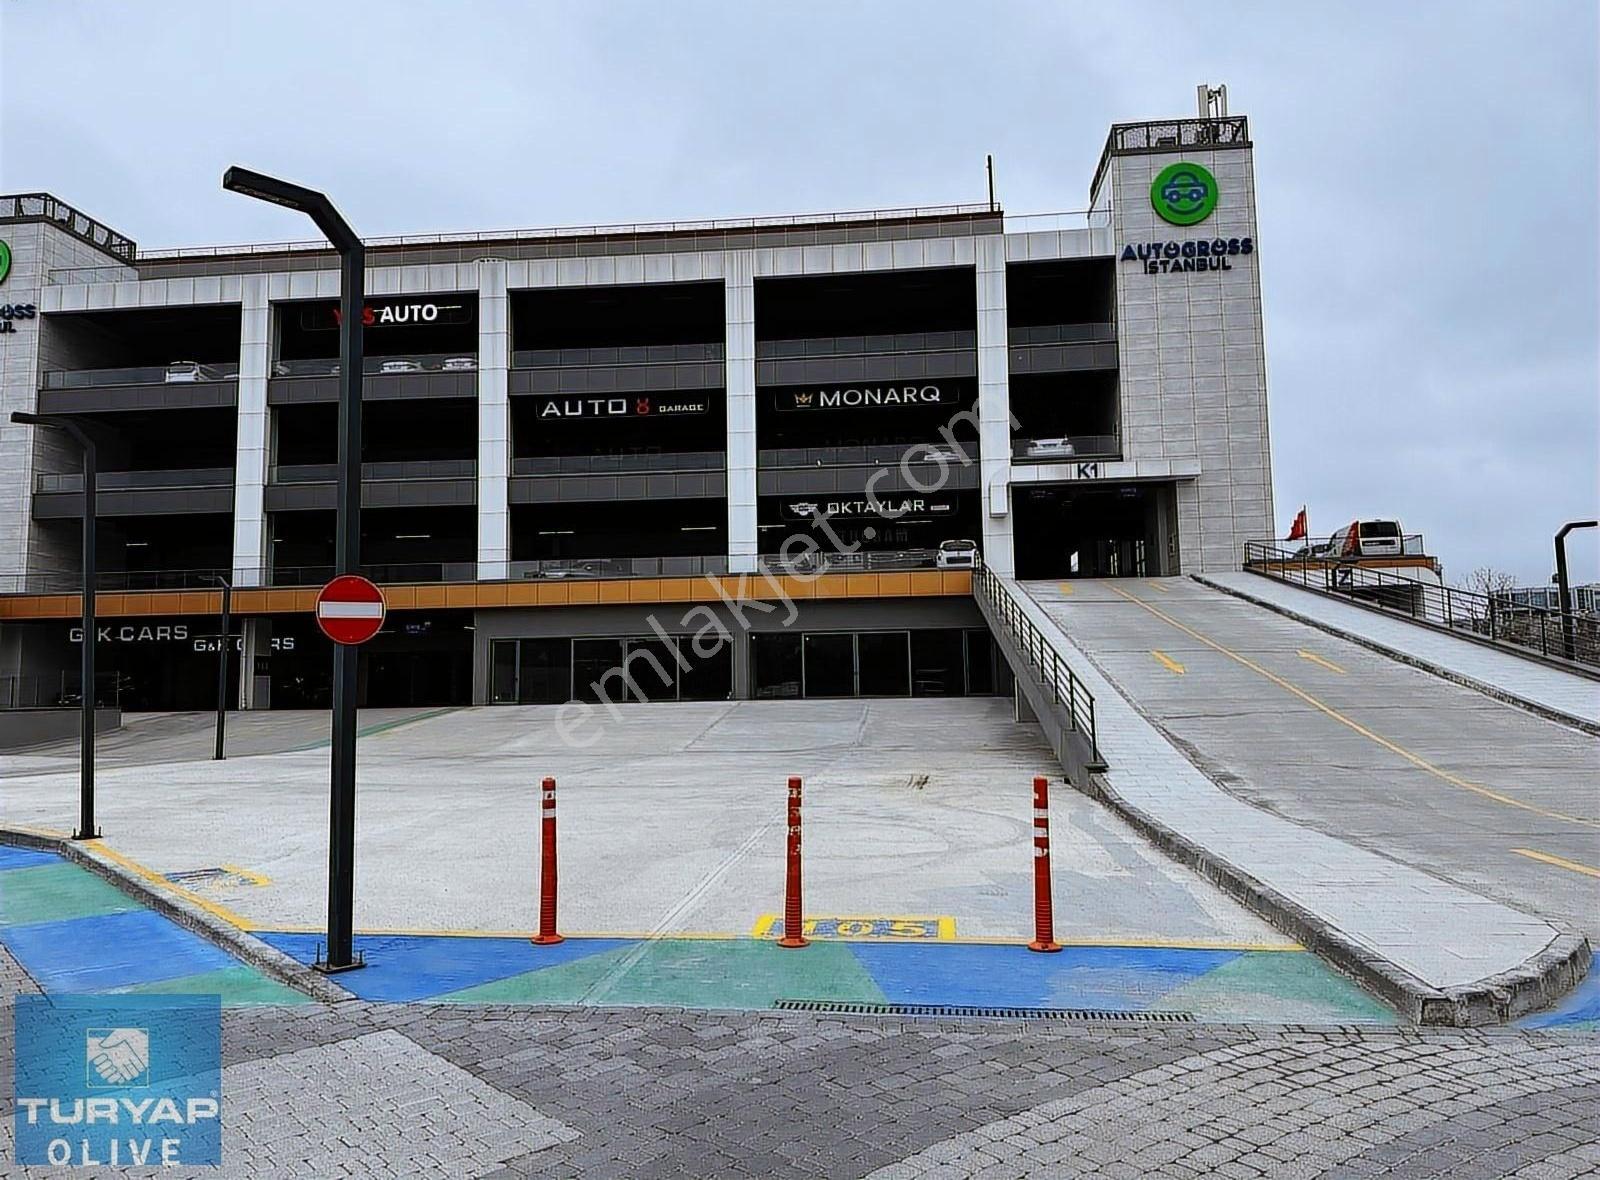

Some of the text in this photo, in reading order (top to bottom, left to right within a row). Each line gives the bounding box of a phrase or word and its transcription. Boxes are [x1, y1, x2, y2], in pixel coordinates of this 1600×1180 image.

[1121, 238, 1253, 262] AUTOGROSS
[380, 304, 438, 323] AUTO
[819, 385, 941, 407] MONARQ
[541, 399, 627, 417] AUTO
[659, 403, 704, 413] GARAGE
[1077, 463, 1098, 478] K1
[826, 499, 925, 514] OKTAYLAR
[69, 625, 188, 642] GK CARS
[236, 637, 295, 651] CRS
